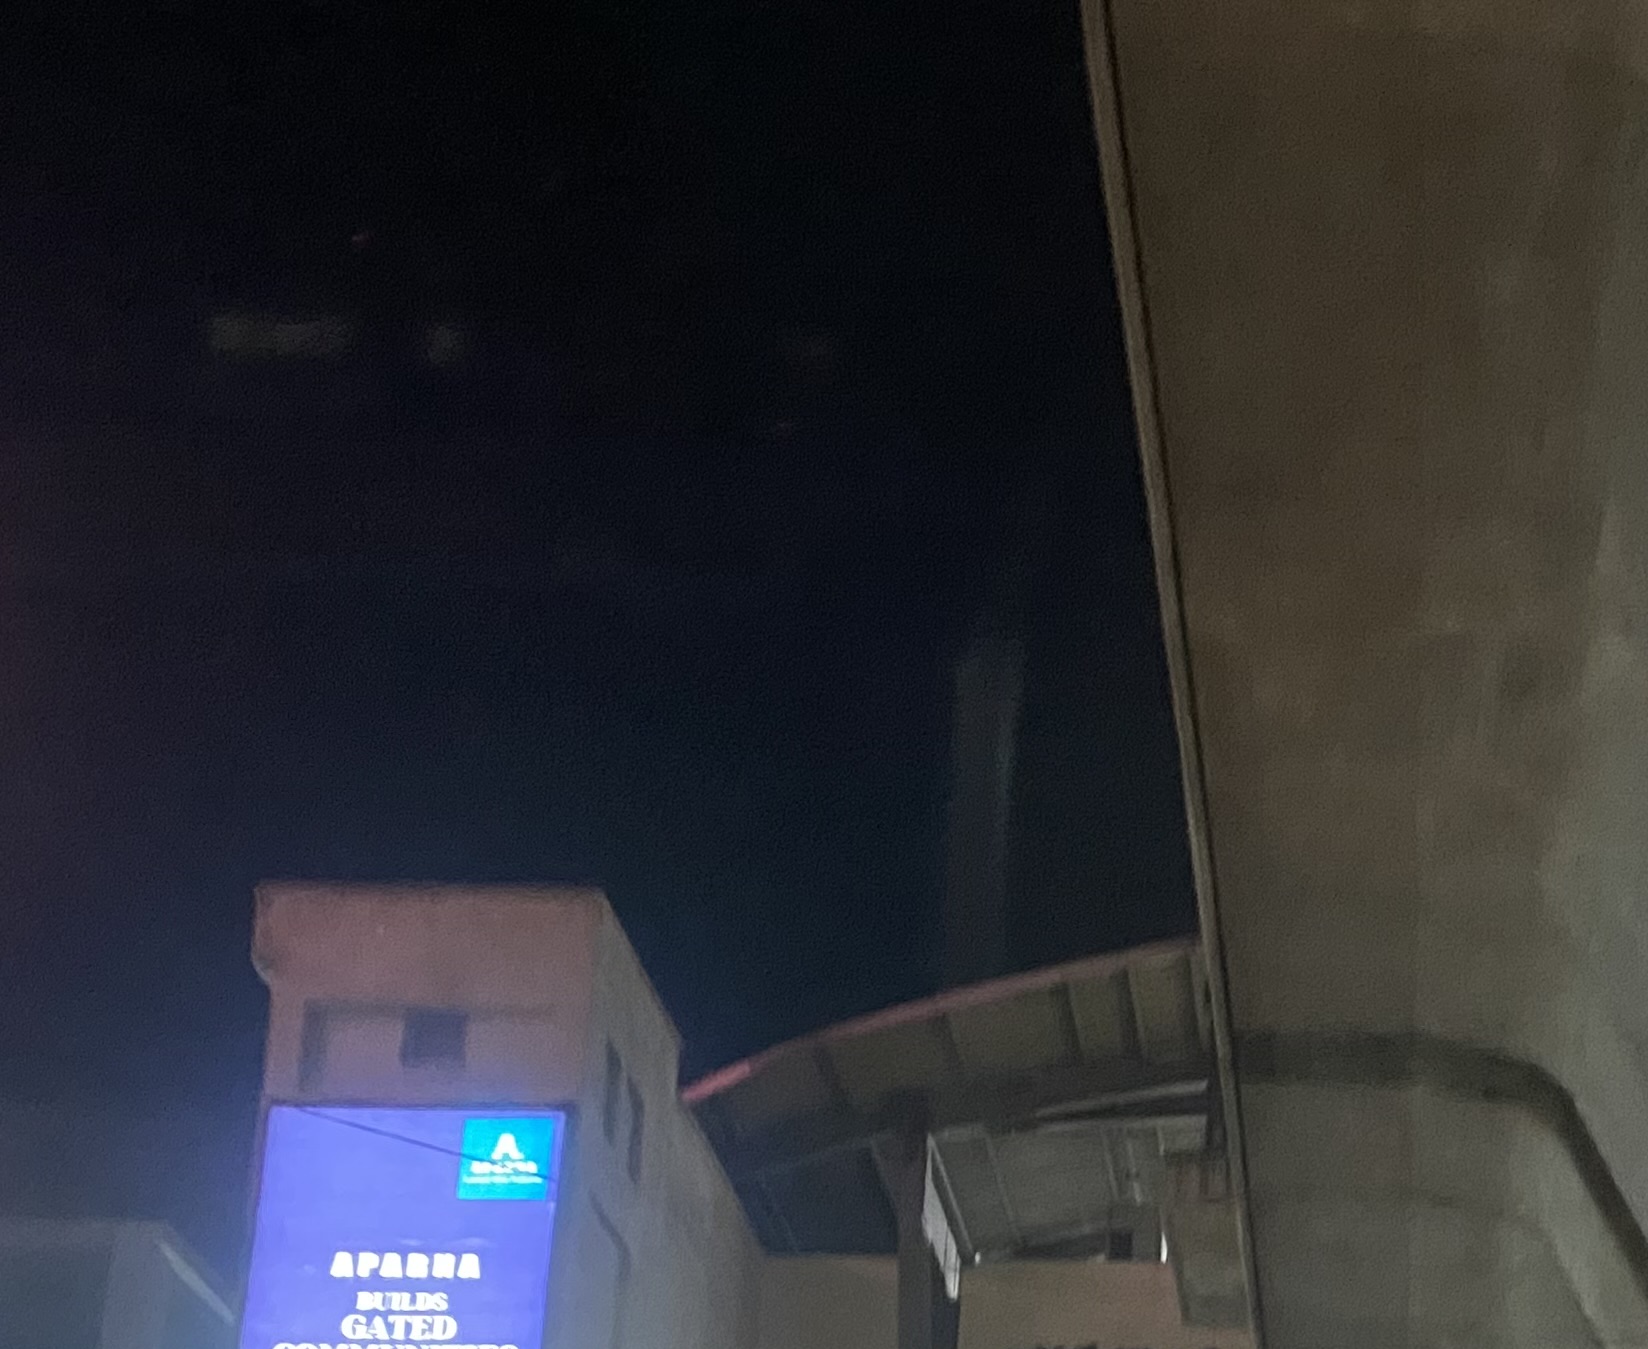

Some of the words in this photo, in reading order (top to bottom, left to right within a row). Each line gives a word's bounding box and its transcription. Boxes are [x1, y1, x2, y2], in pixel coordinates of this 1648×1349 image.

[329, 1251, 481, 1279] APARNA
[355, 1291, 449, 1311] BUILDS
[340, 1314, 457, 1340] GATED
